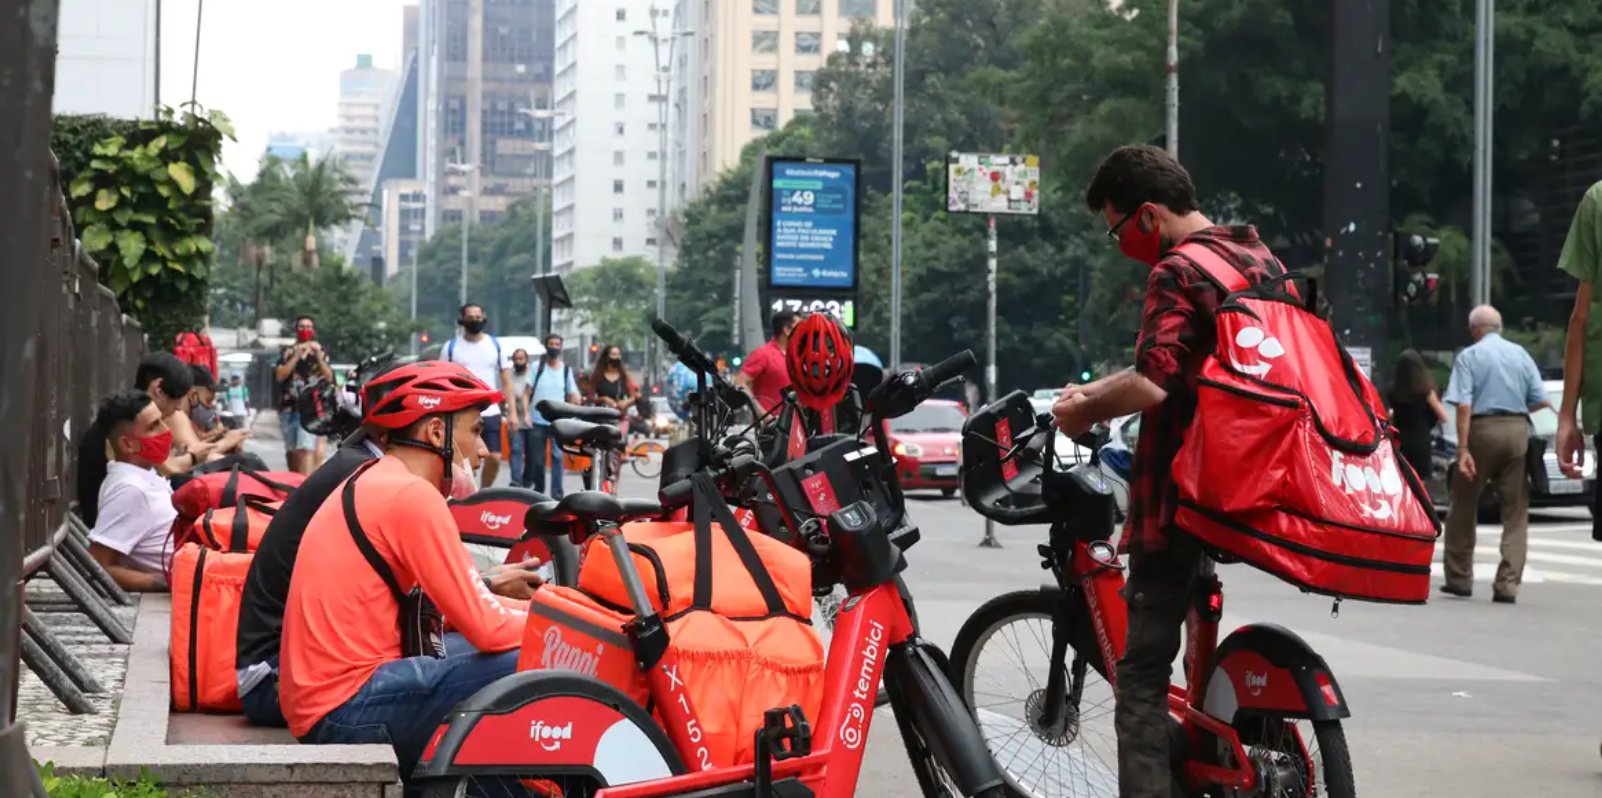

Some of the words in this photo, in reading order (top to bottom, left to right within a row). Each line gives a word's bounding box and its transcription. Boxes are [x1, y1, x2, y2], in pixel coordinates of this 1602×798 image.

[792, 190, 815, 206] 49
[480, 510, 511, 525] ifood
[853, 620, 884, 700] tembici
[530, 720, 572, 742] ifood
